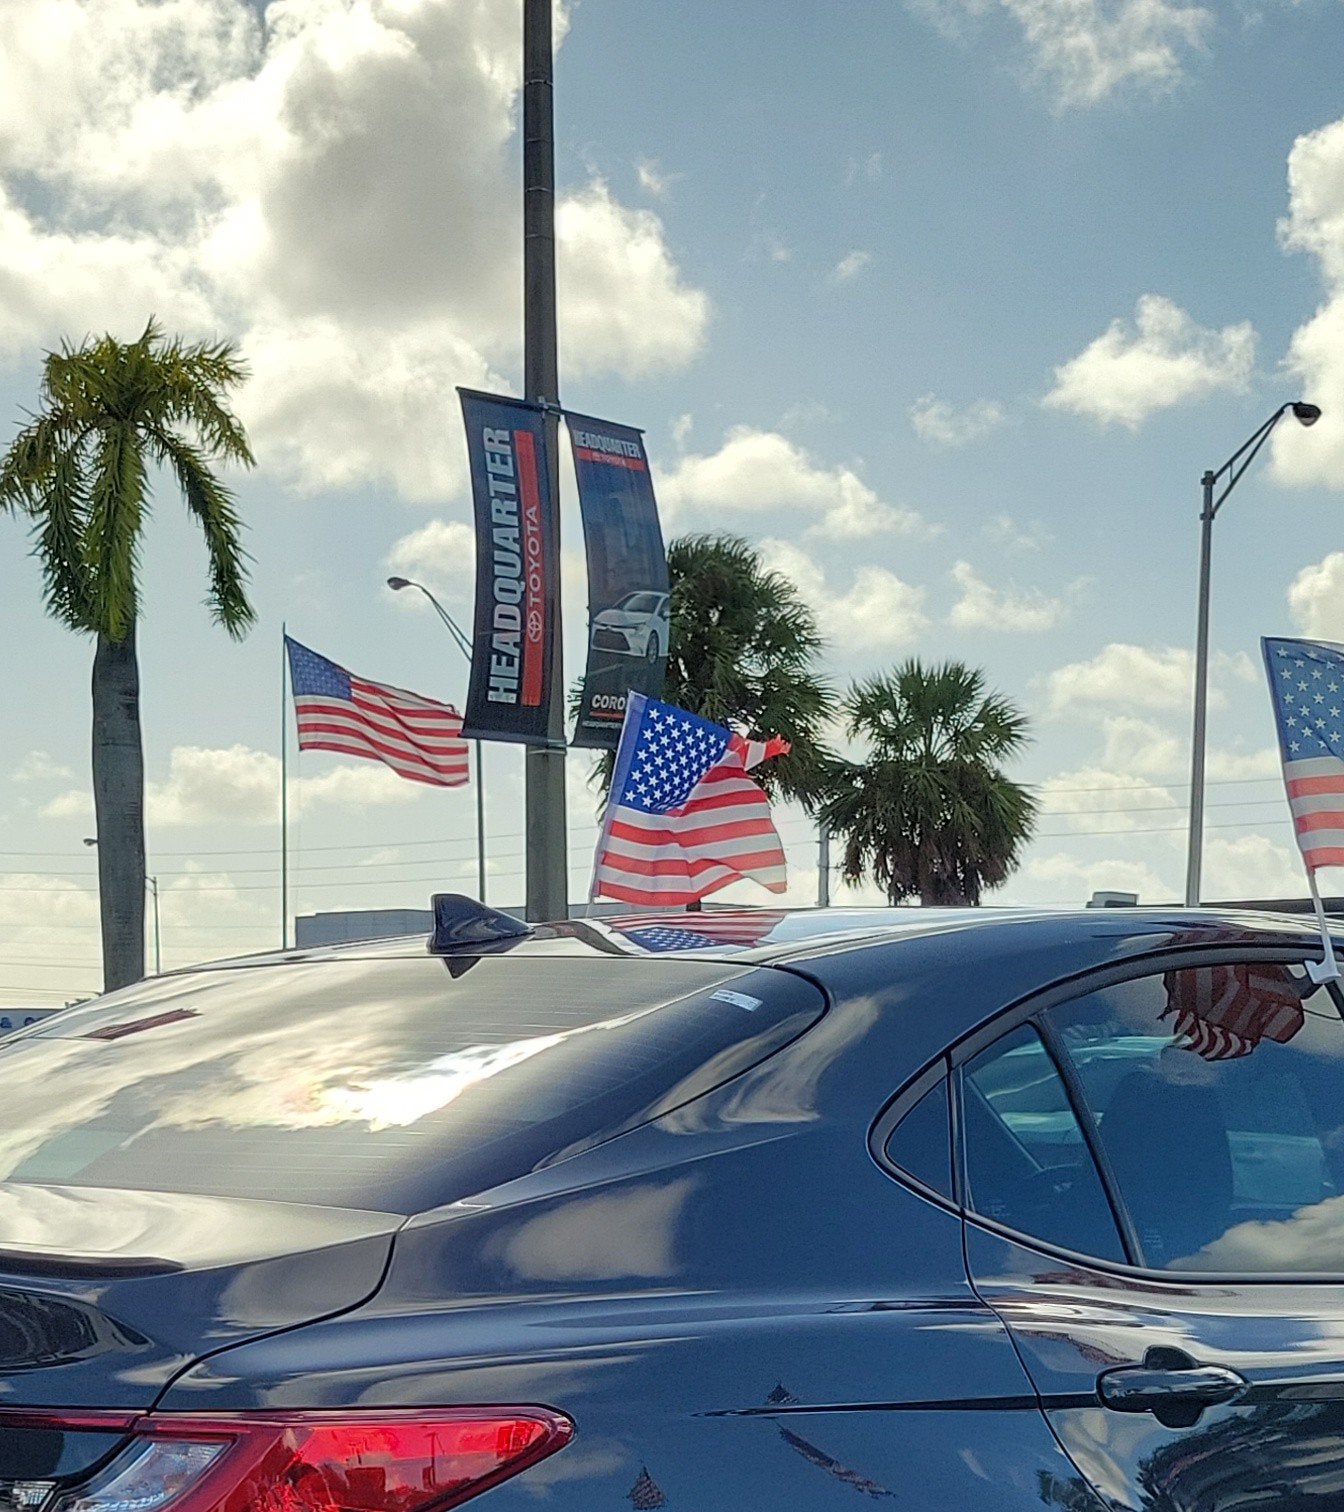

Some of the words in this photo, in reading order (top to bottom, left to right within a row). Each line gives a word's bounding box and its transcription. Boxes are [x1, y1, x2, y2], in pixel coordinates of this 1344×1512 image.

[482, 426, 525, 704] HEADQUARTER
[525, 505, 542, 607] TOYOTA
[592, 694, 626, 710] CORO
